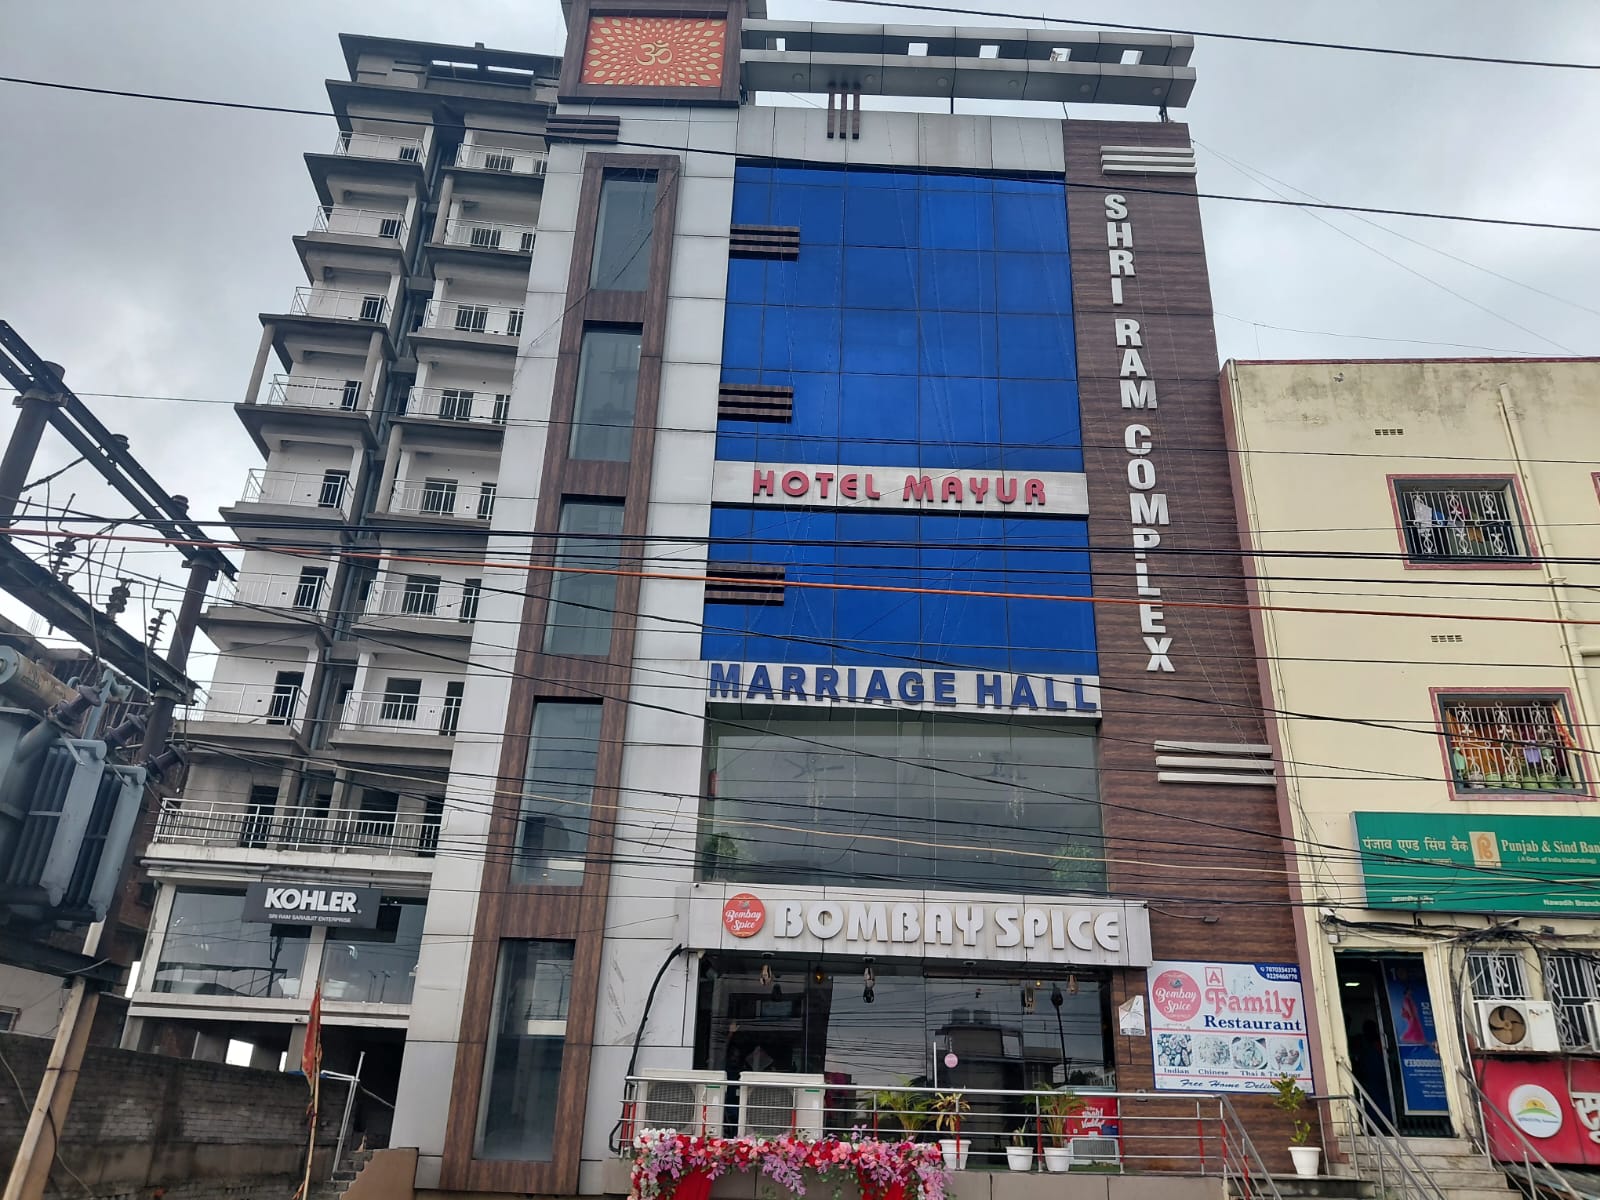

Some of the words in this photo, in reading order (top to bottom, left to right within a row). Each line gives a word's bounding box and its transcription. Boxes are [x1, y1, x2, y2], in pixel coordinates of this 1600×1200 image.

[1104, 194, 1136, 305] SHRI
[1115, 319, 1158, 409] RAM
[752, 469, 881, 499] HOTEL
[903, 475, 1046, 505] MAYUR
[1125, 424, 1175, 672] COMPLEX
[710, 663, 957, 706] MARRIAGE
[976, 674, 1097, 711] HALL
[1502, 839, 1539, 855] Punjab
[1541, 840, 1551, 853] &
[1553, 840, 1578, 853] Sind
[1579, 841, 1600, 854] Ban
[264, 887, 358, 913] KOHLER
[725, 909, 761, 922] Bombay
[733, 919, 755, 931] Spice
[774, 901, 984, 946] BOMBAY
[994, 906, 1120, 952] SPICE
[1156, 987, 1196, 1003] Bombay
[1205, 988, 1296, 1019] Family
[1165, 999, 1191, 1013] Spice
[1204, 1014, 1302, 1031] Restaurant
[1163, 1067, 1190, 1075] Indian
[1198, 1068, 1229, 1076] Chinese
[1180, 1079, 1203, 1087] Free
[1208, 1080, 1240, 1088] Home
